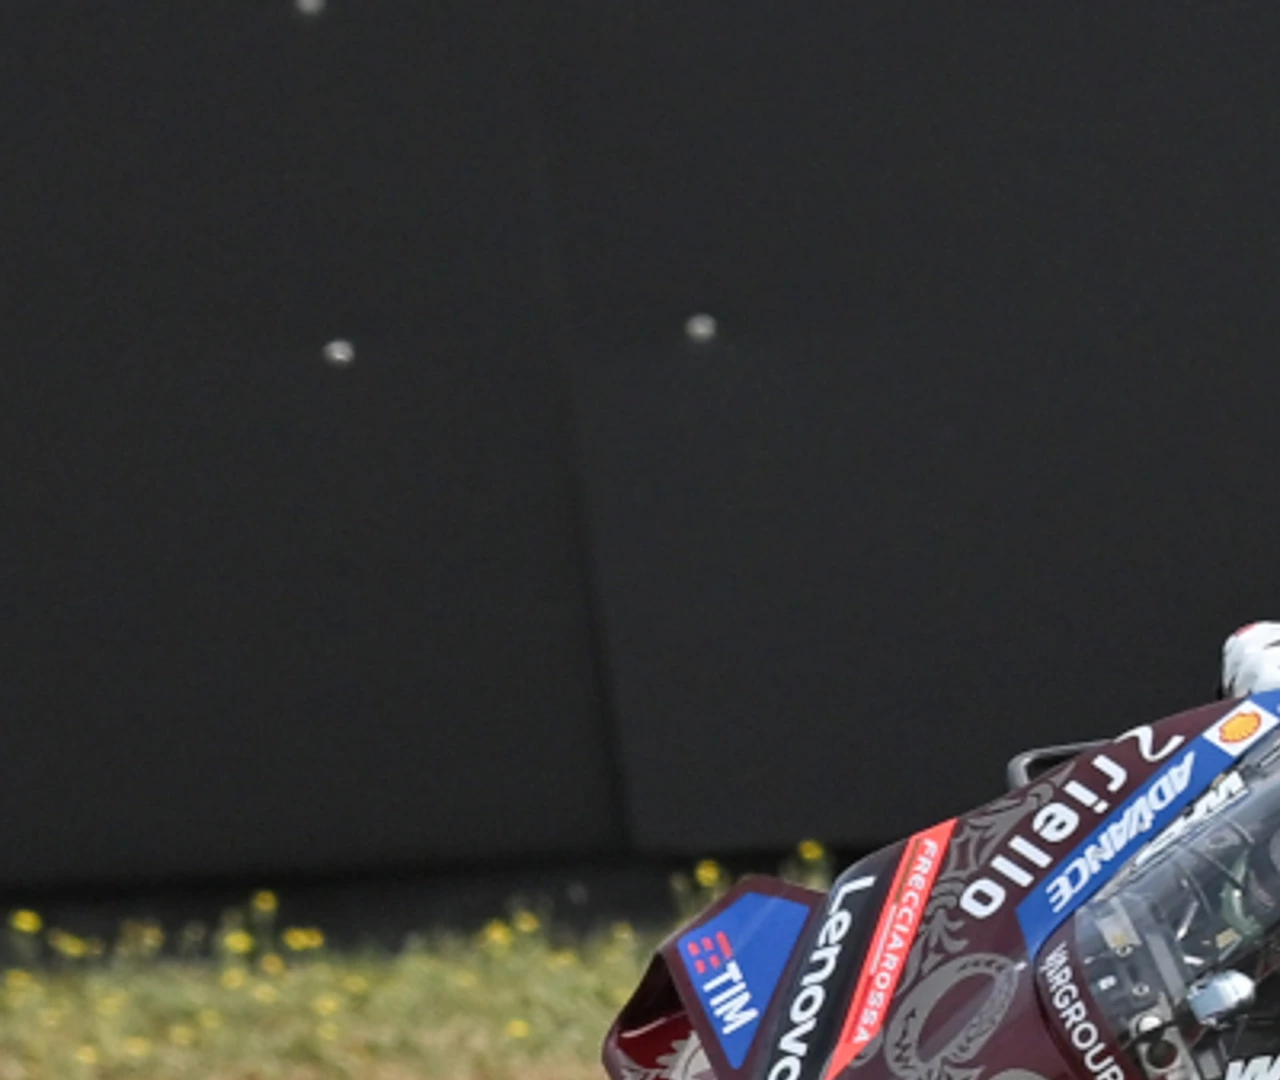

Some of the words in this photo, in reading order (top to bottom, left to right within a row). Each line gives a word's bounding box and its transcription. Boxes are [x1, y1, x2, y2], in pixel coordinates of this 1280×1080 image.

[960, 752, 1128, 919] riello
[1046, 750, 1196, 913] ADVANCE
[703, 958, 760, 1036] TIM
[853, 838, 939, 1044] FRECCIAROSSA
